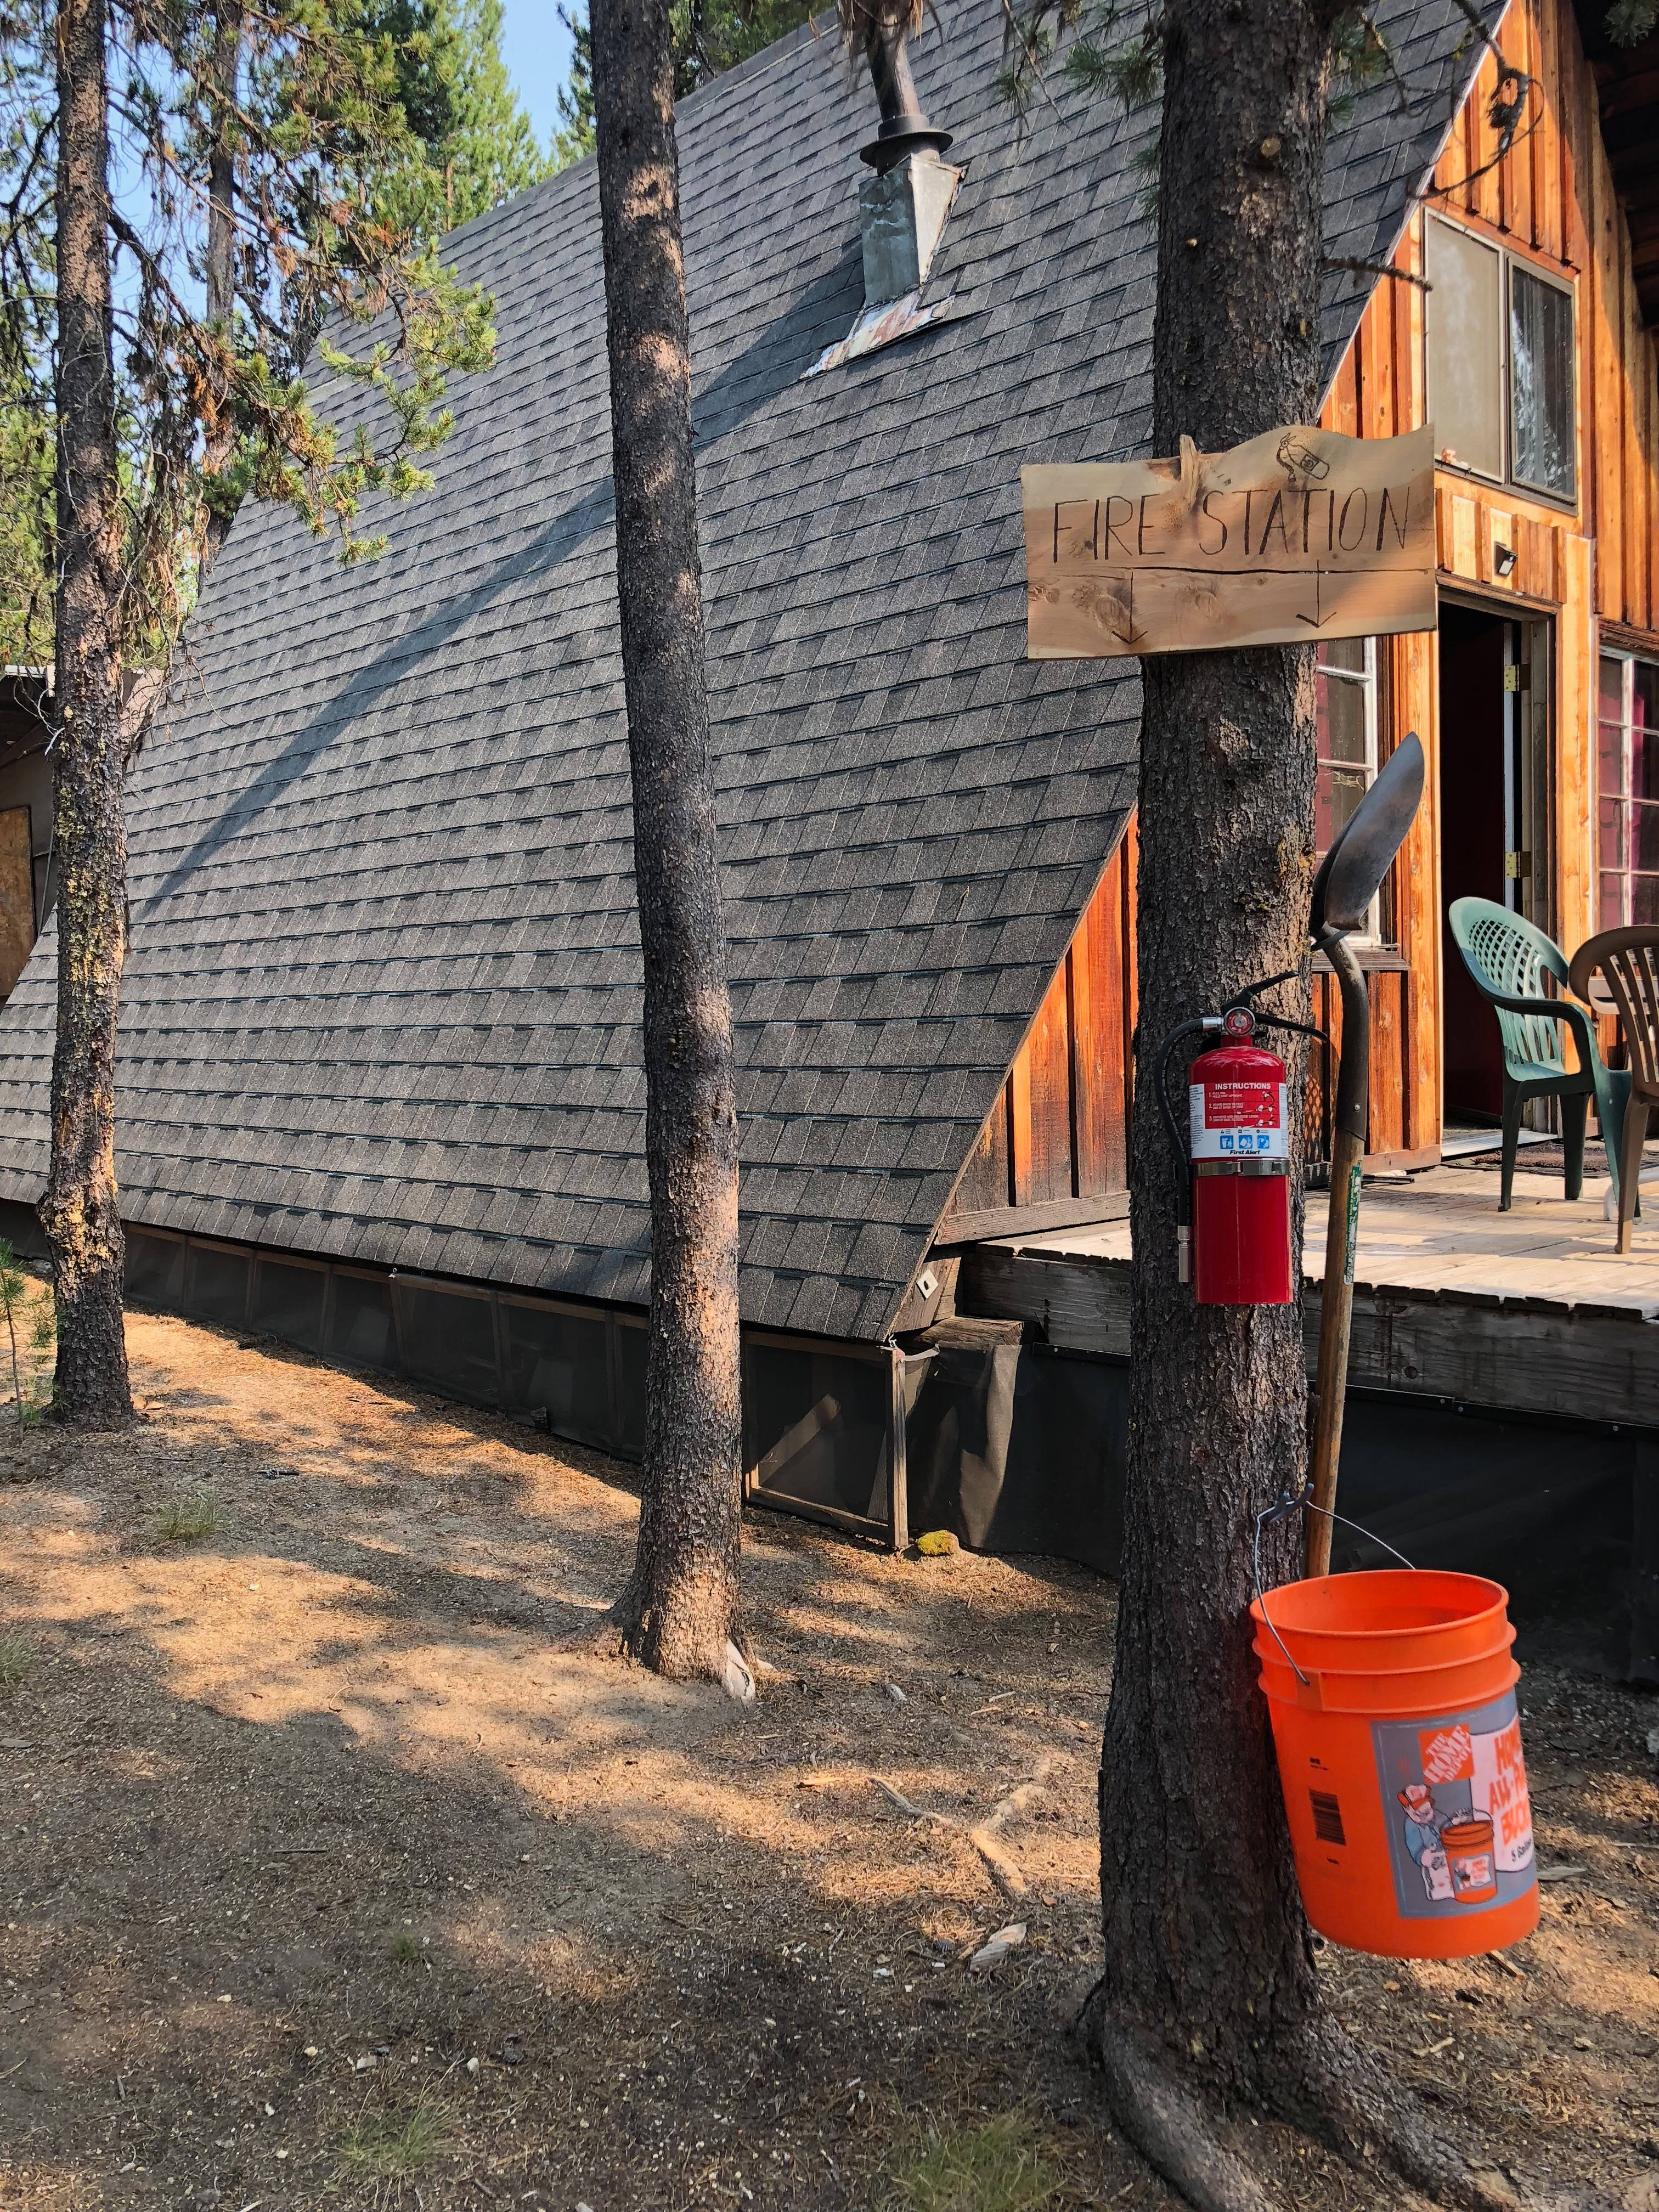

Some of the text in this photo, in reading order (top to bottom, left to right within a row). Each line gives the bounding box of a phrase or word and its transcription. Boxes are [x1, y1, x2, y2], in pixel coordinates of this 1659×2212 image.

[1053, 486, 1410, 563] FIRE STATION
[1423, 1725, 1471, 1783] HOME
[1425, 1732, 1449, 1757] THE
